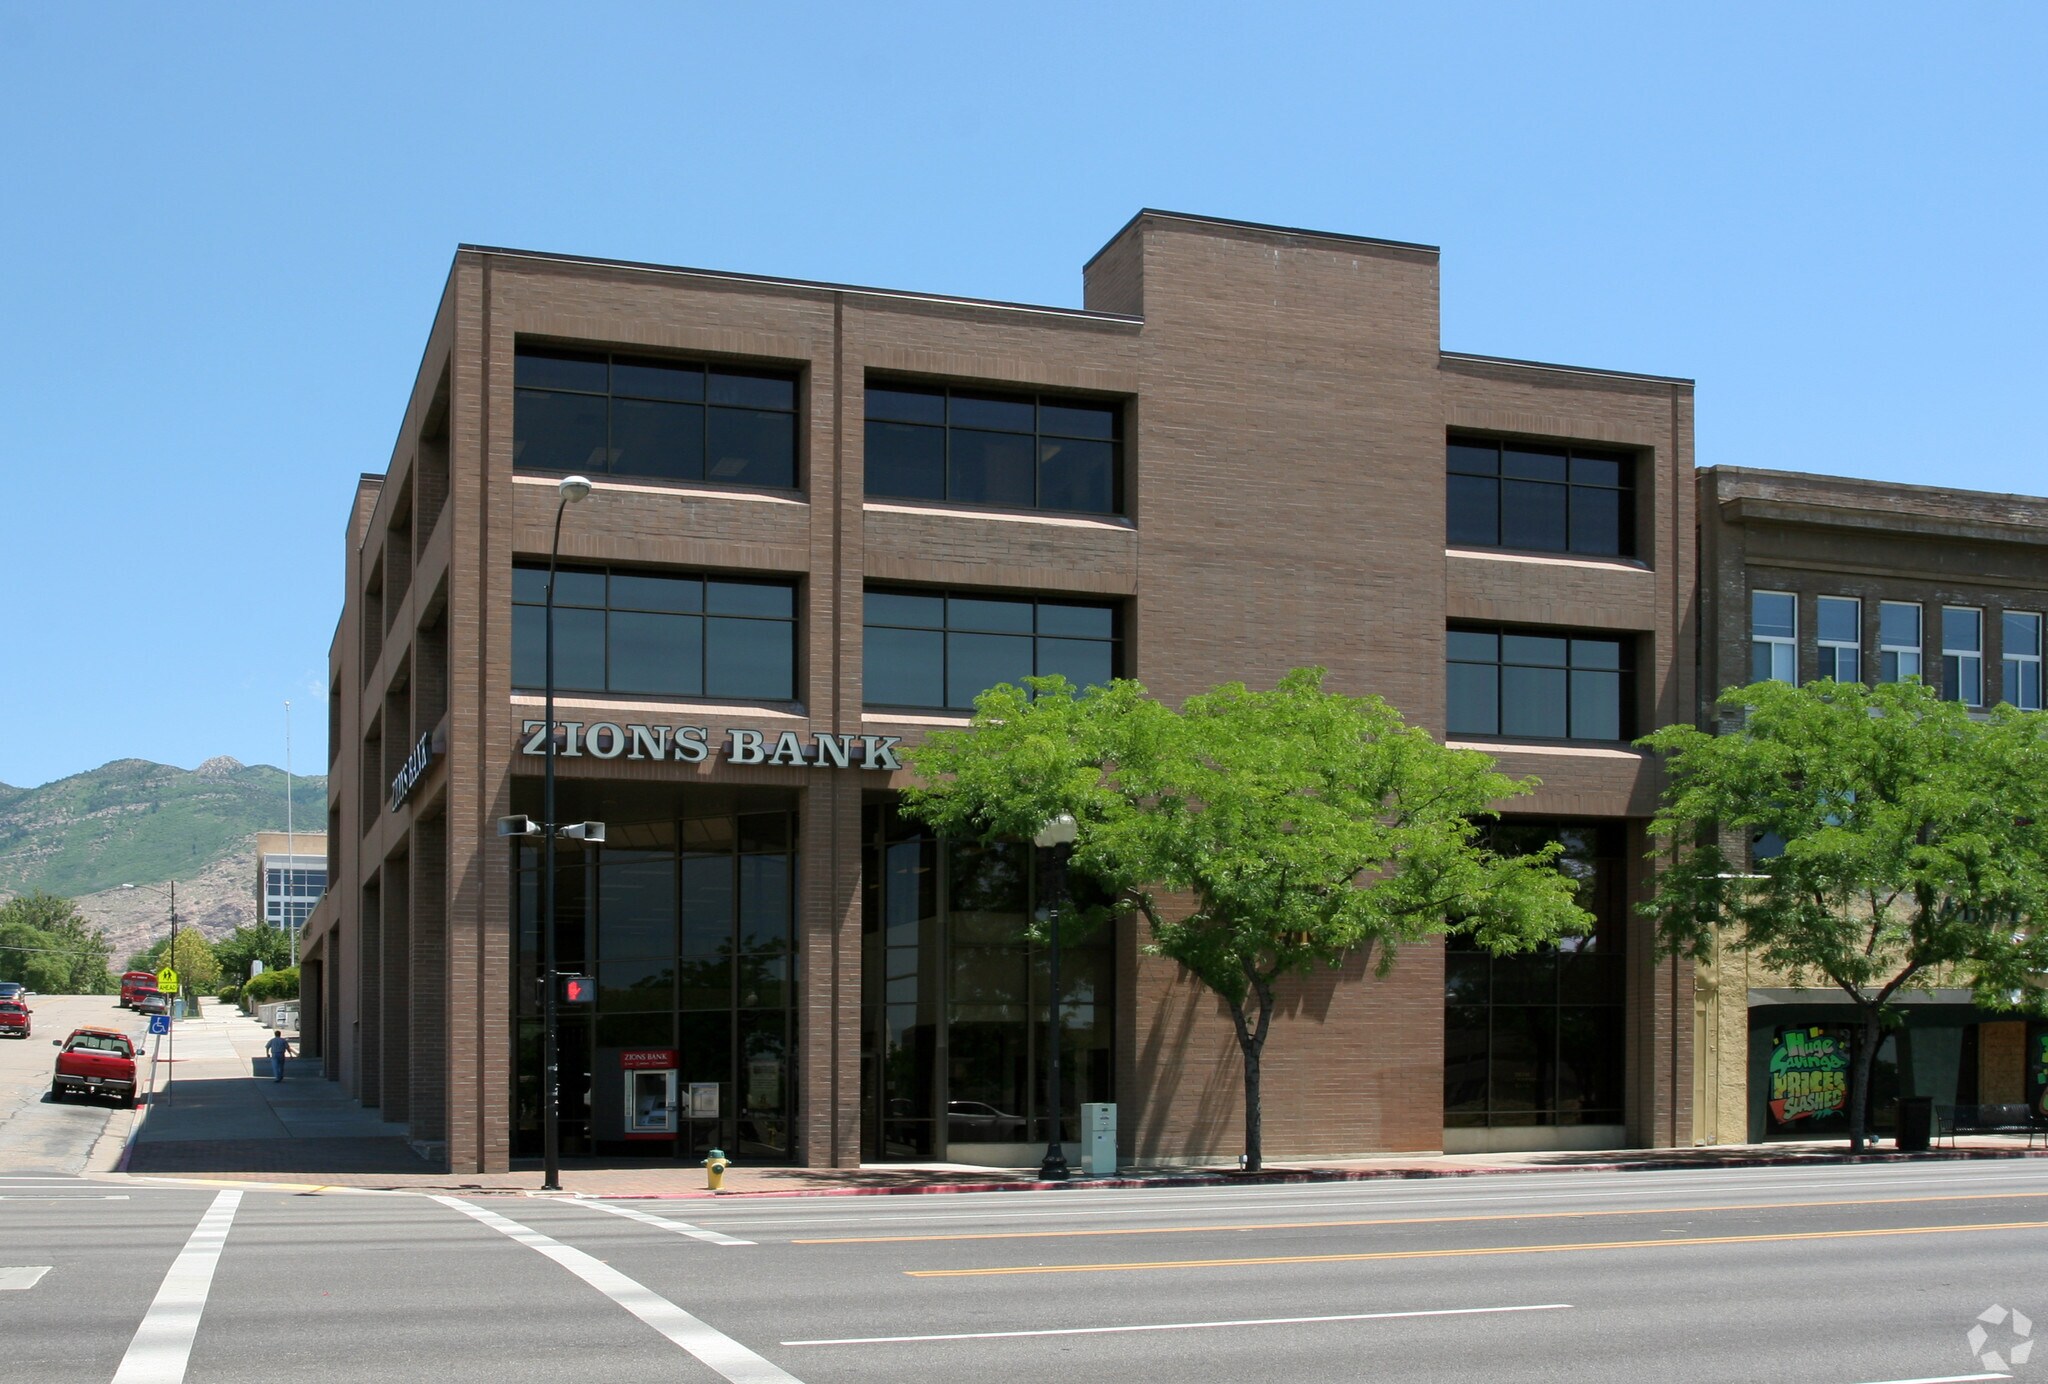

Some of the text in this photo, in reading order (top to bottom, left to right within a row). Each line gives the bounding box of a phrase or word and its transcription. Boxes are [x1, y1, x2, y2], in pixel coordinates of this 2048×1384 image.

[522, 719, 903, 771] ZIONS BANK
[624, 1053, 646, 1061] ZIONS
[1785, 1032, 1835, 1058] Huge
[1769, 1047, 1846, 1078] Savings
[1773, 1071, 1846, 1100] PRICES
[1783, 1089, 1843, 1120] SLASHED
